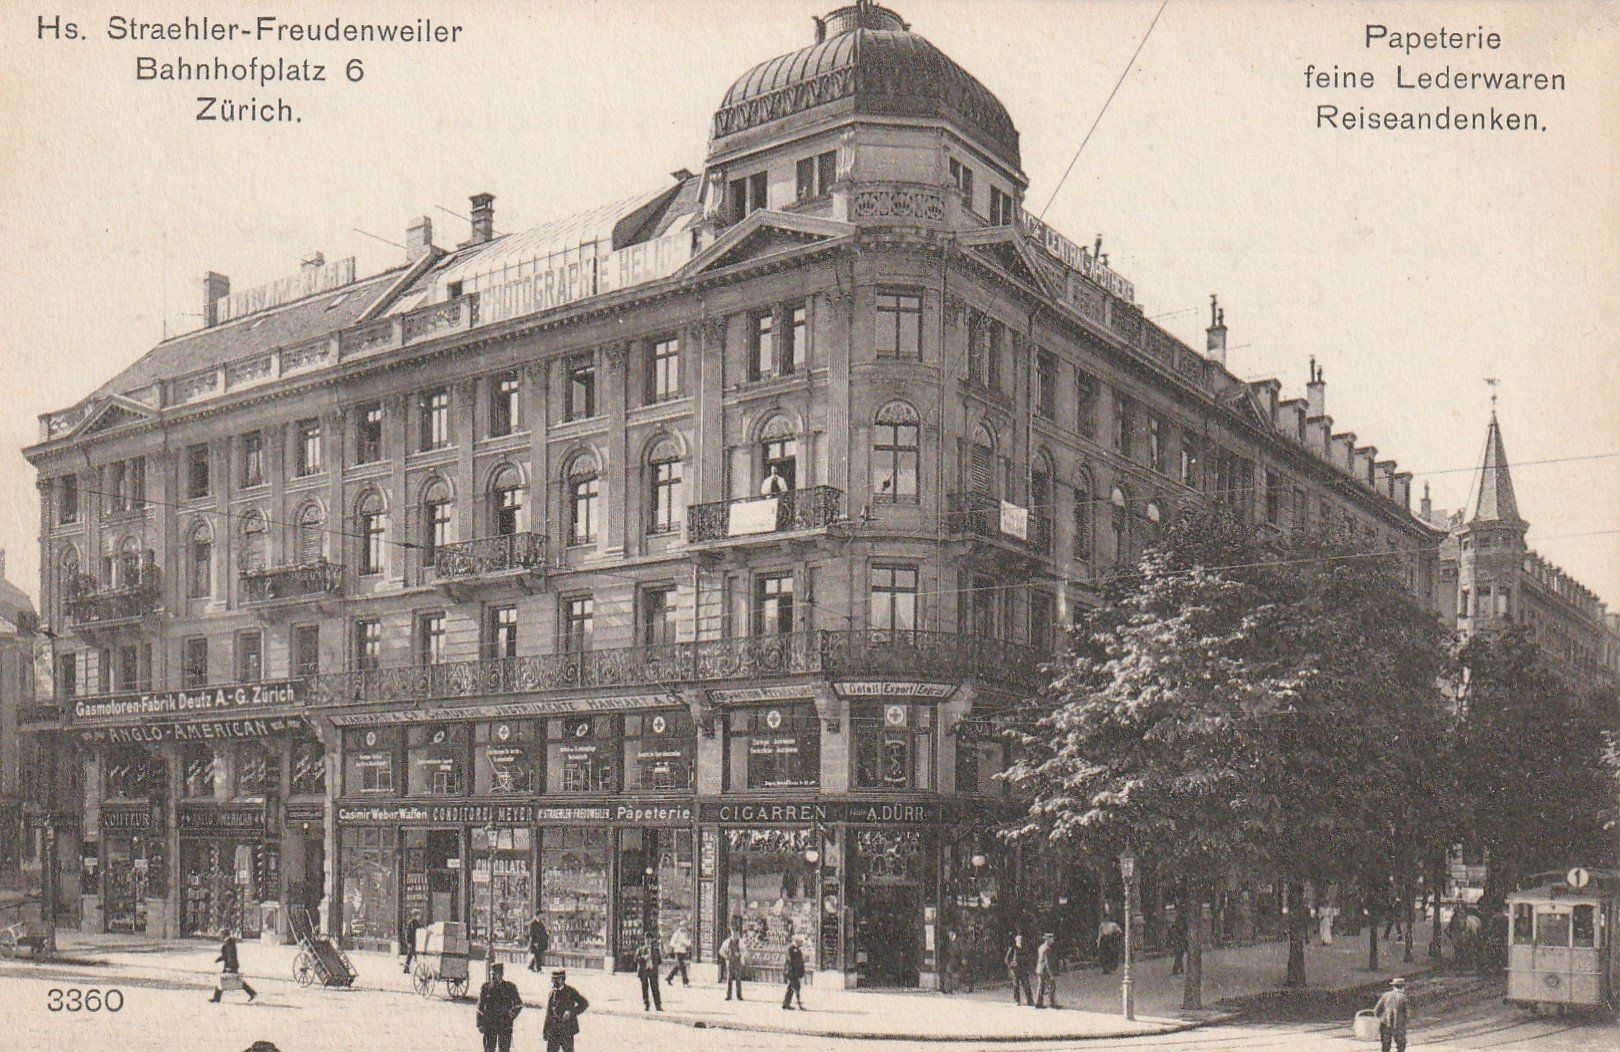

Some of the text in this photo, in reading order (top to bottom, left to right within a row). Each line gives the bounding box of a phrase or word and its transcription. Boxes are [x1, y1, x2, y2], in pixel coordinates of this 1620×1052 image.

[252, 683, 294, 703] Zürich
[497, 806, 532, 821] MEYER
[719, 805, 826, 821] CIGARREN
